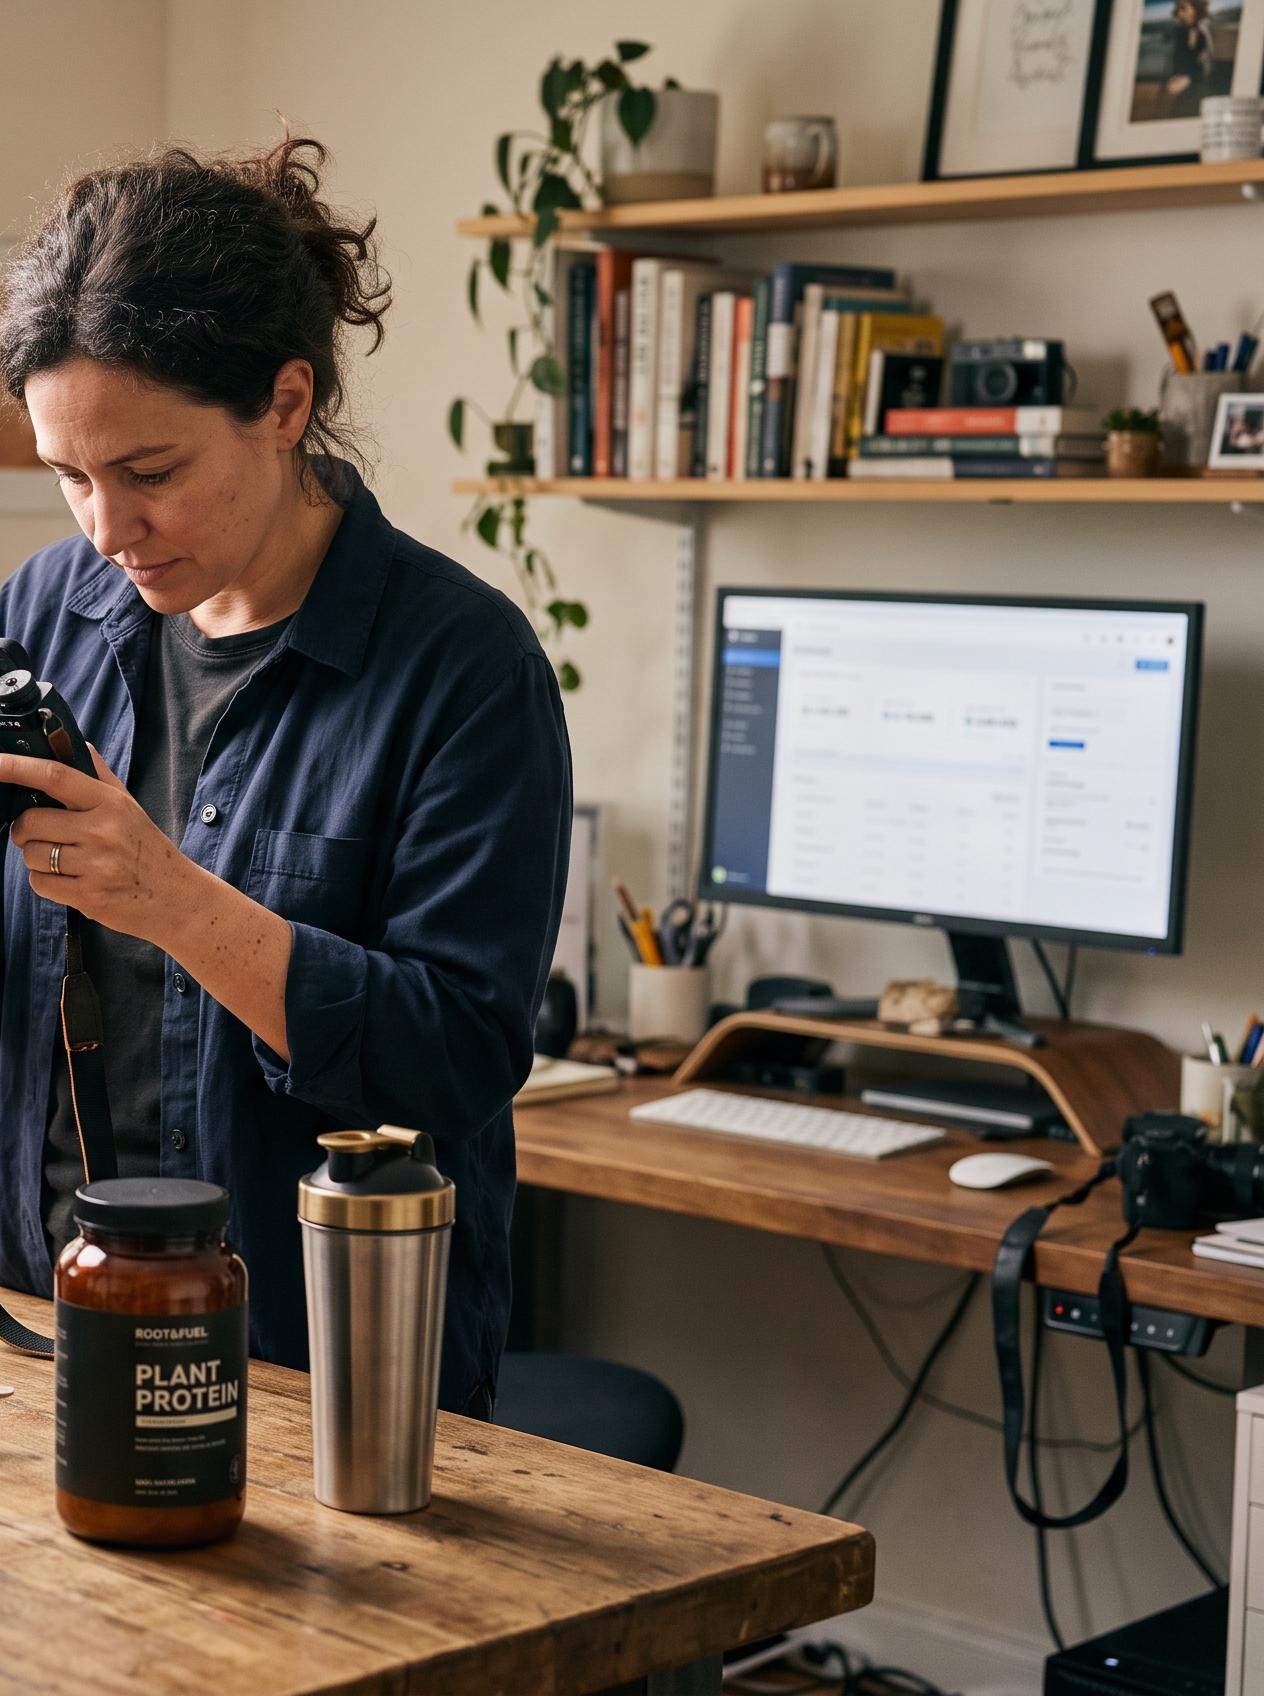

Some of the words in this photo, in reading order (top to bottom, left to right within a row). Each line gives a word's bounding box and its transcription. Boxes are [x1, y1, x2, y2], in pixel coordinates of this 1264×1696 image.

[135, 1326, 209, 1340] ROOT&FUEL
[136, 1359, 221, 1387] PLANT
[136, 1380, 239, 1412] PROTEIN
